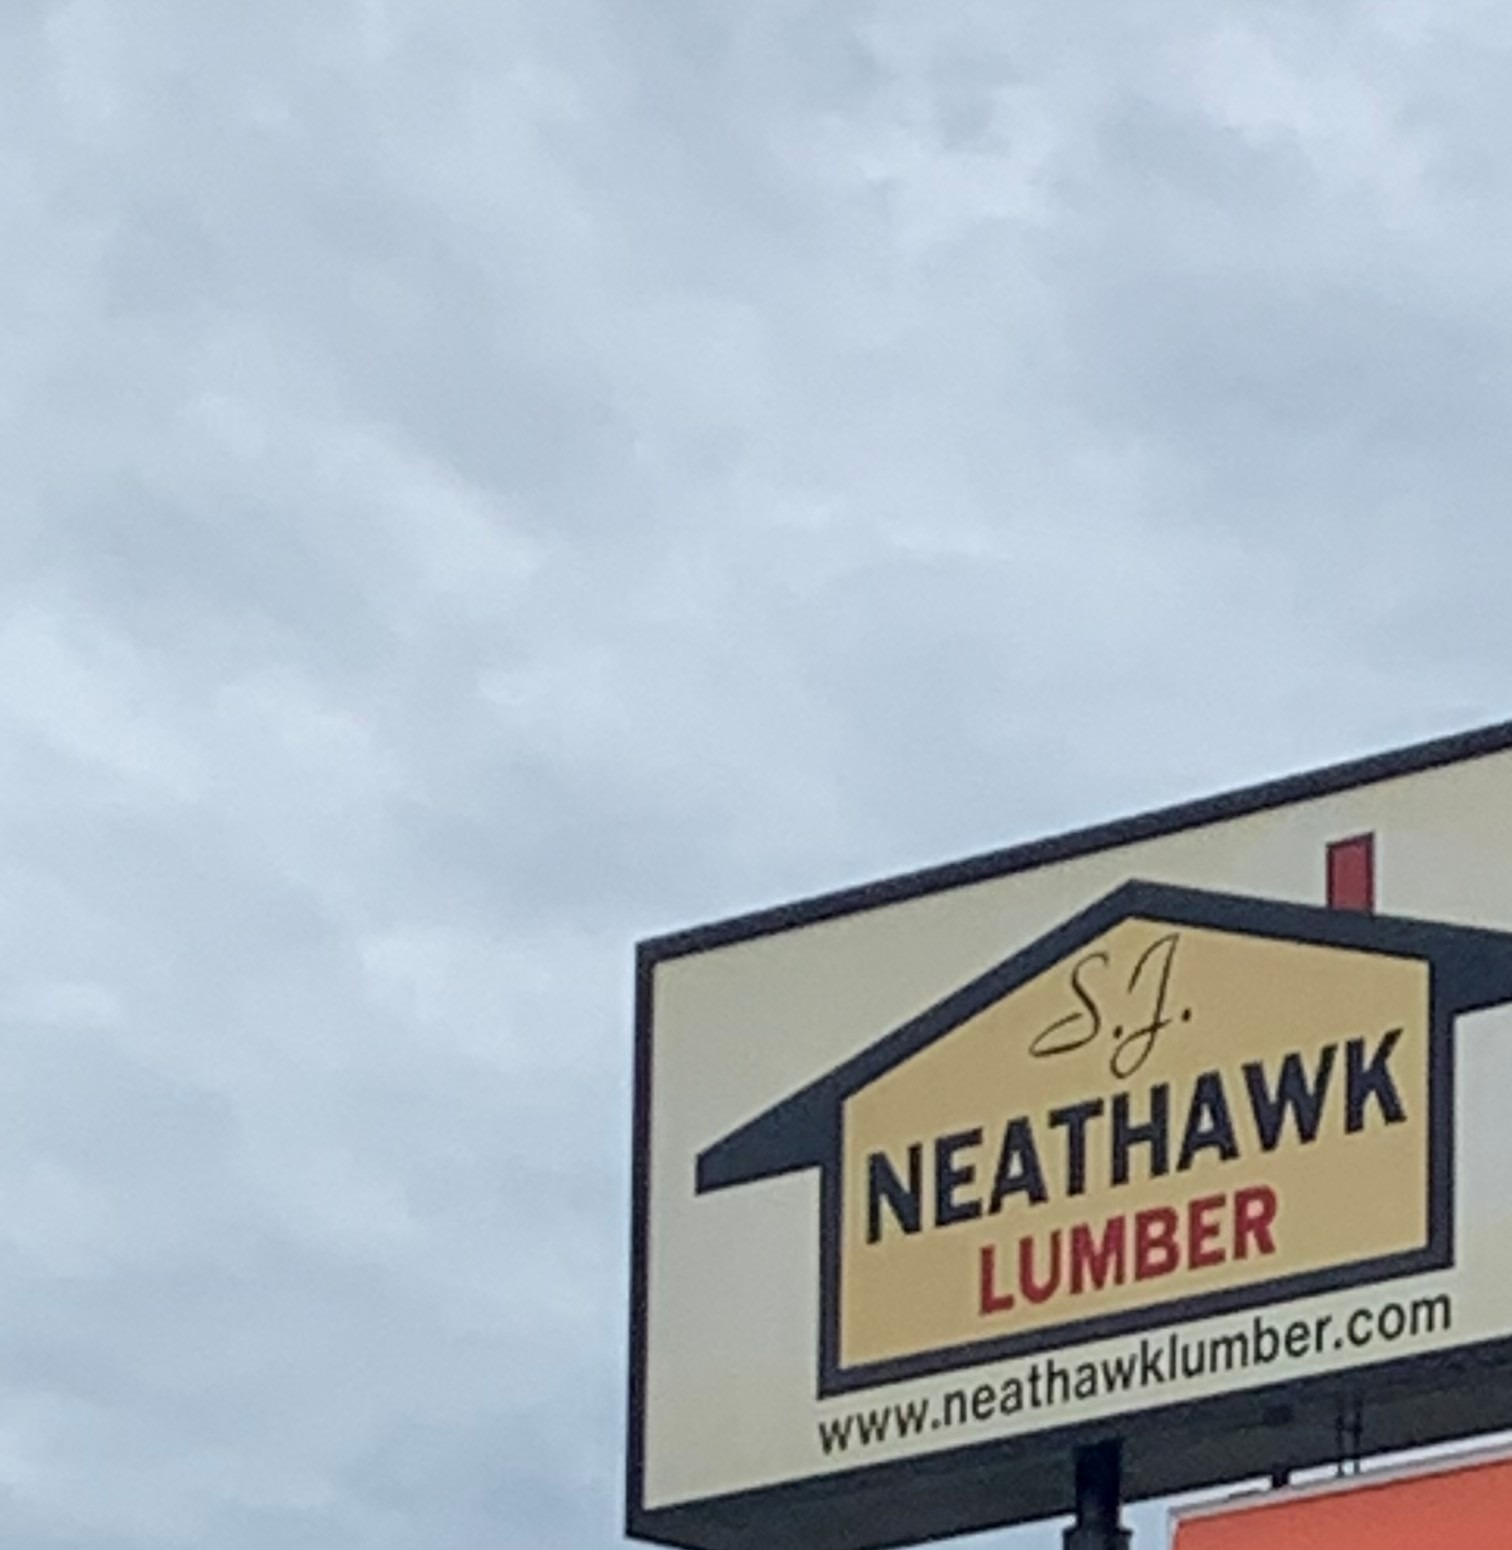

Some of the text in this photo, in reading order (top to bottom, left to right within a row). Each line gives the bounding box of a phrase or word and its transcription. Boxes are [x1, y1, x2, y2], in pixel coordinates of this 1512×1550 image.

[1029, 934, 1192, 1078] S.J.
[866, 1028, 1406, 1244] NEATHAWK
[979, 1185, 1279, 1315] LUMBER
[818, 1294, 1452, 1453] www.neathawklumber.com
